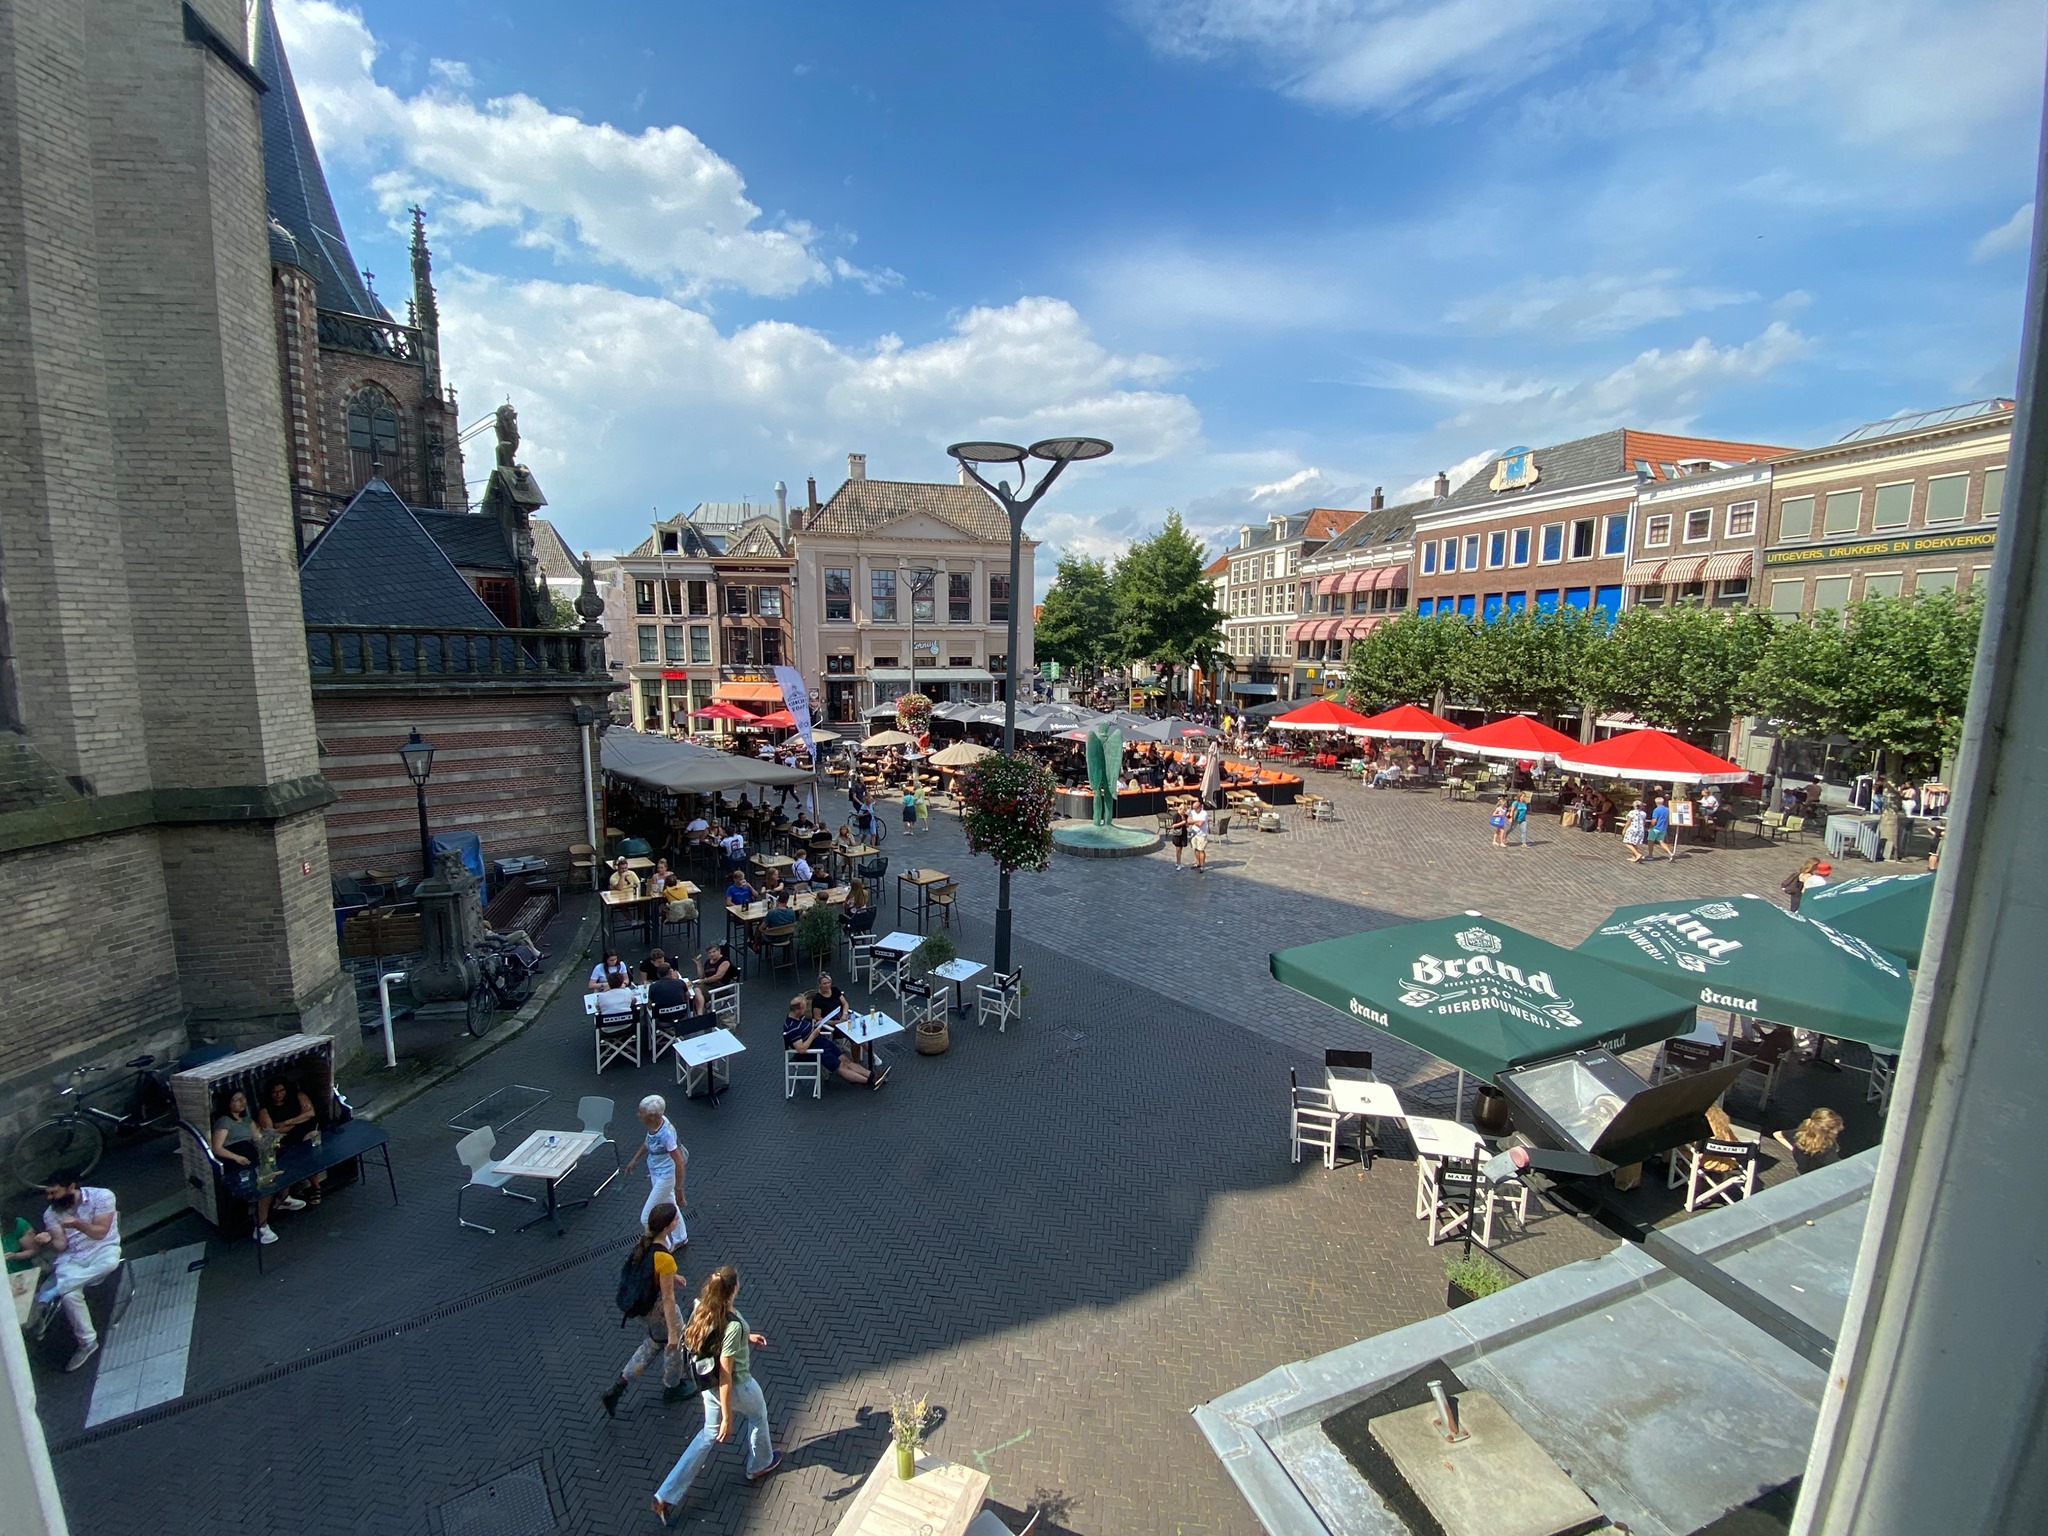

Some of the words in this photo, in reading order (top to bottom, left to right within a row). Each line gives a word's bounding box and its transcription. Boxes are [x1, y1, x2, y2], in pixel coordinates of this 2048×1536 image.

[1829, 543, 1888, 557] DRUKKERS
[1893, 541, 1909, 551] EN
[1412, 953, 1561, 1000] Brand
[1471, 986, 1512, 1000] 1340
[1700, 987, 1757, 1012] Brand
[1350, 998, 1389, 1027] Brand
[1438, 998, 1551, 1029] BIERBROUWERIJ
[1709, 1143, 1747, 1154] MAXIM'S
